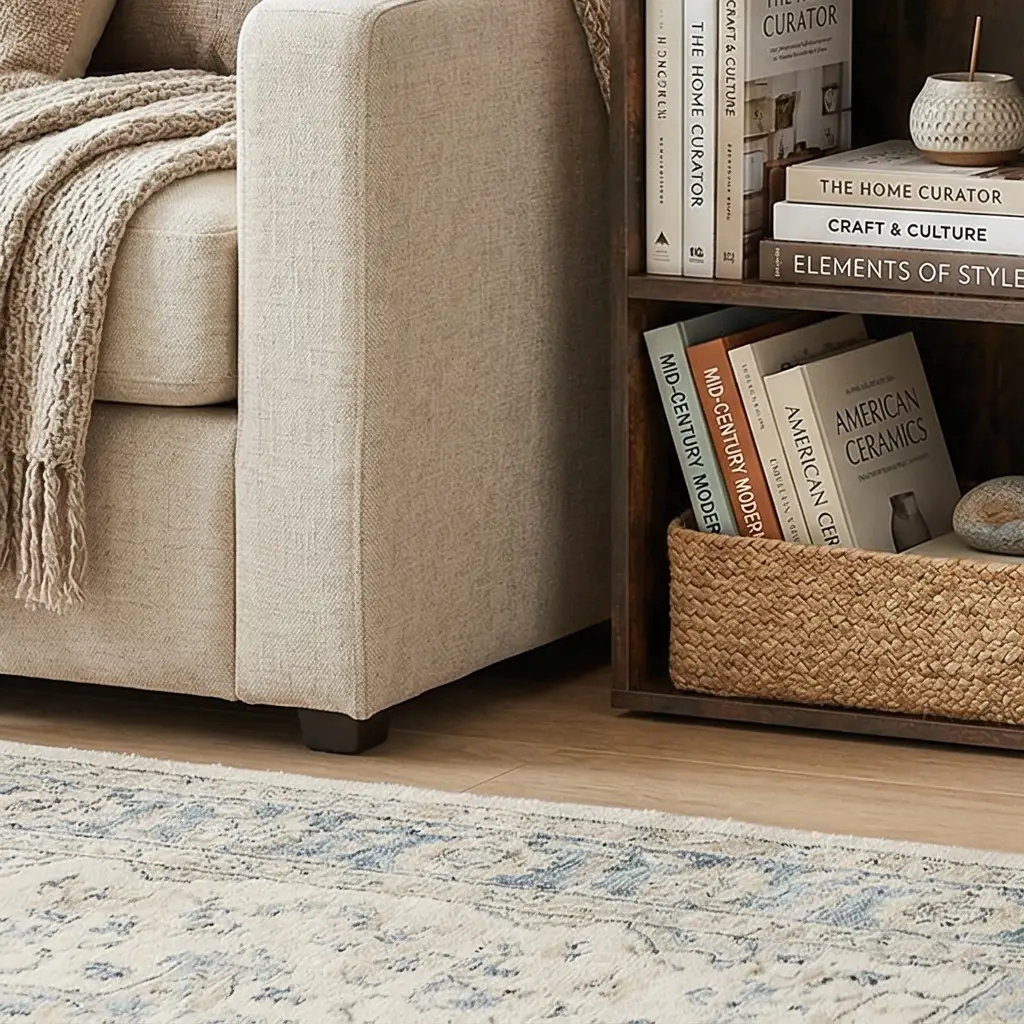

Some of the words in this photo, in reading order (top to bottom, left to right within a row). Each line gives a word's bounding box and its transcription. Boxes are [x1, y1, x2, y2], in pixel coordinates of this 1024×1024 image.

[691, 22, 704, 57] THE
[763, 5, 837, 37] CURATOR
[690, 65, 704, 116] HOME
[690, 125, 704, 208] CURATOR
[820, 180, 853, 195] THE
[861, 182, 912, 199] HOME
[919, 186, 1002, 204] CURATOR
[828, 218, 885, 235] CRAFT
[891, 224, 901, 237] &
[907, 224, 988, 242] CULTURE
[794, 254, 909, 280] ELEMENTS
[919, 263, 949, 284] OF
[660, 353, 704, 468] MID-CENTURY
[704, 367, 748, 474] MID-CENTURY
[836, 388, 920, 435] AMERICAN
[785, 406, 828, 507] AMERICAN
[845, 418, 927, 465] CERAMICS
